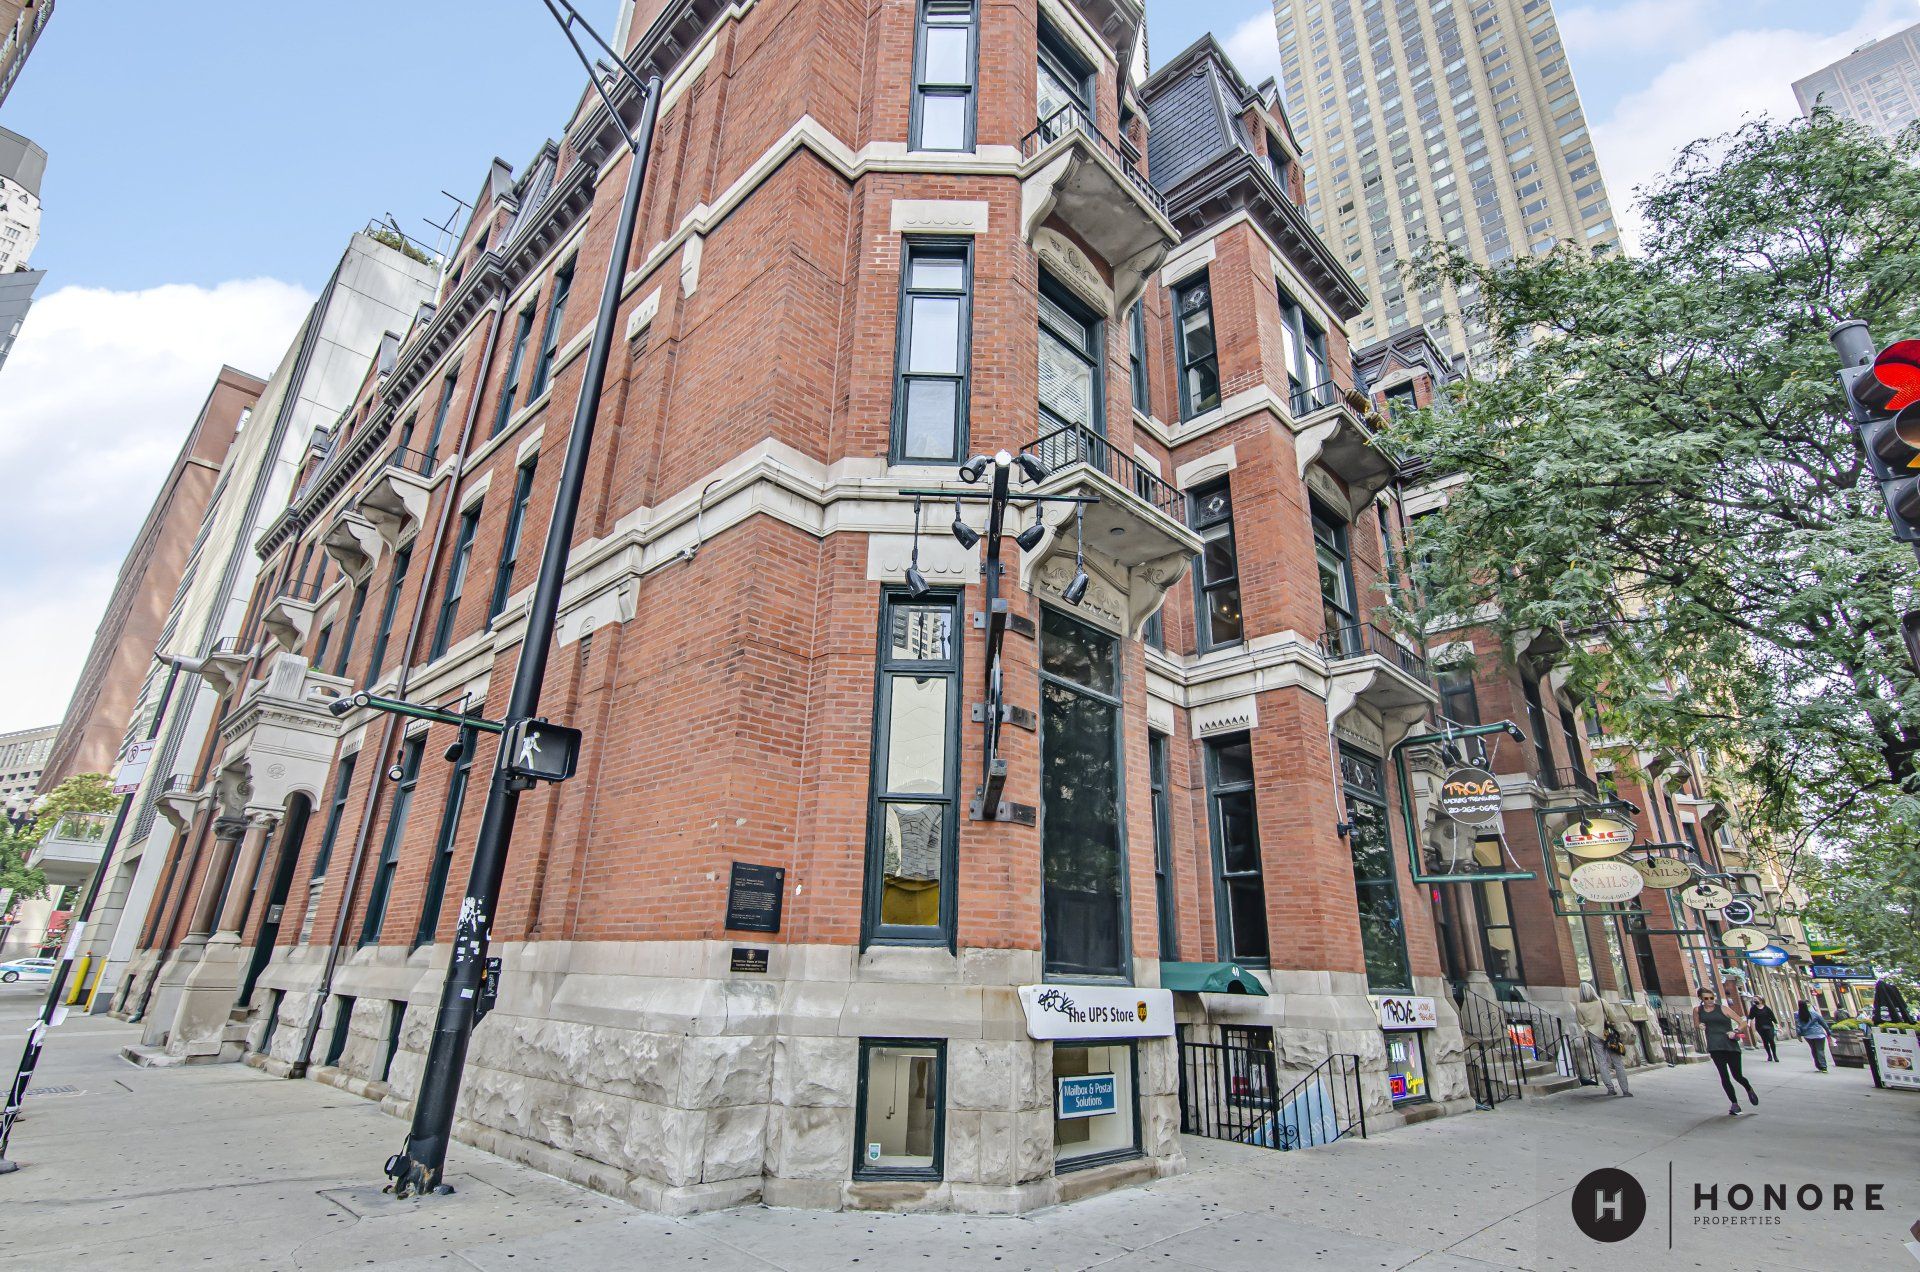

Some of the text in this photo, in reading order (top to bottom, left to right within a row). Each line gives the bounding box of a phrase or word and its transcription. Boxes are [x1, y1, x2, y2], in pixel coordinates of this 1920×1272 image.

[1443, 779, 1500, 796] TROVE
[1565, 830, 1629, 842] GNC
[1582, 863, 1623, 874] FANTASY
[1641, 868, 1680, 877] NAILS
[1583, 875, 1629, 889] NAILS
[1068, 1007, 1134, 1023] The UPS Store
[1382, 998, 1416, 1025] TROVE
[1064, 1081, 1113, 1097] Mailbox & Postal
[1075, 1095, 1102, 1109] Solutions
